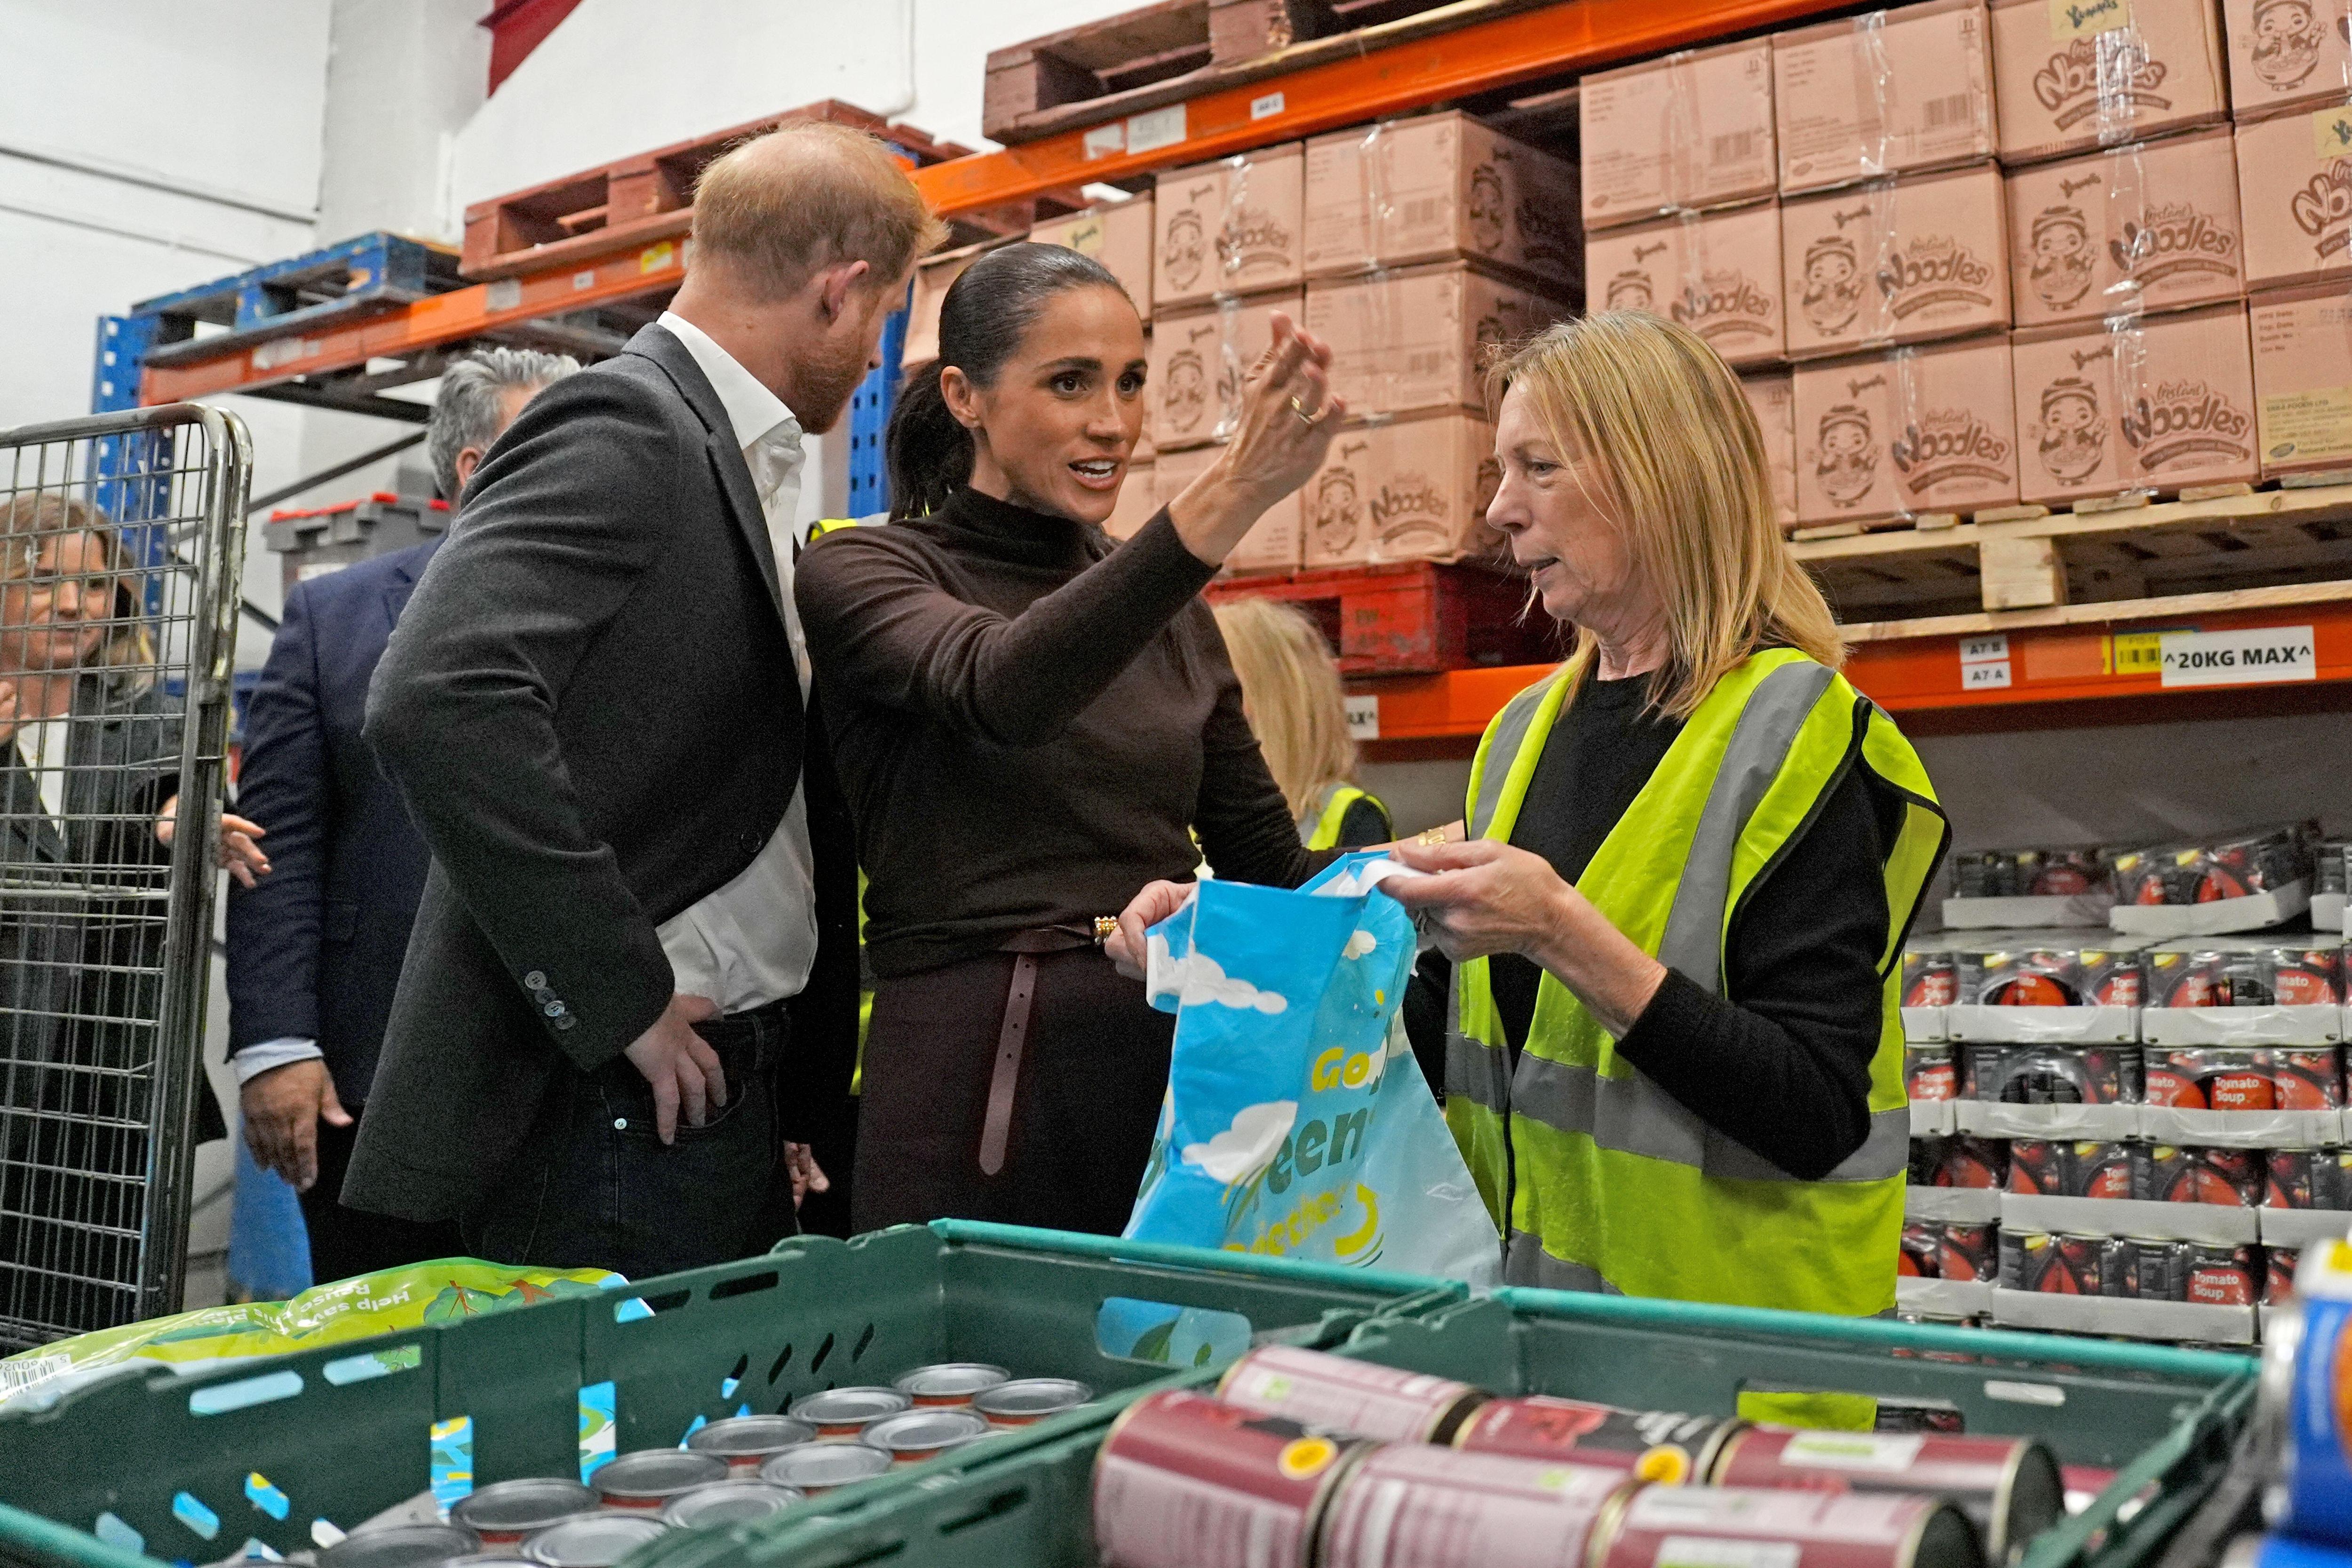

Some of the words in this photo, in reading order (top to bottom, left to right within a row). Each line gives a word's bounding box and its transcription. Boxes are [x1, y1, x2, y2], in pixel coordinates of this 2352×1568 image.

[1875, 249, 1987, 298] Noodles
[1671, 283, 1770, 321] Noodles
[2121, 395, 2246, 448] Noodles
[1891, 424, 2005, 473] Noodles
[1370, 485, 1448, 527] Noodles
[1994, 669, 2003, 679] A
[1311, 1047, 1370, 1092] Go
[2214, 1076, 2260, 1089] Tomato
[2216, 1090, 2245, 1104] Soup
[1268, 1107, 1368, 1194] een
[2193, 1270, 2239, 1285] Tomato
[300, 1284, 370, 1313] Reuse
[356, 1290, 410, 1311] Help
[2193, 1284, 2225, 1301] Soup
[301, 1302, 350, 1327] sav
